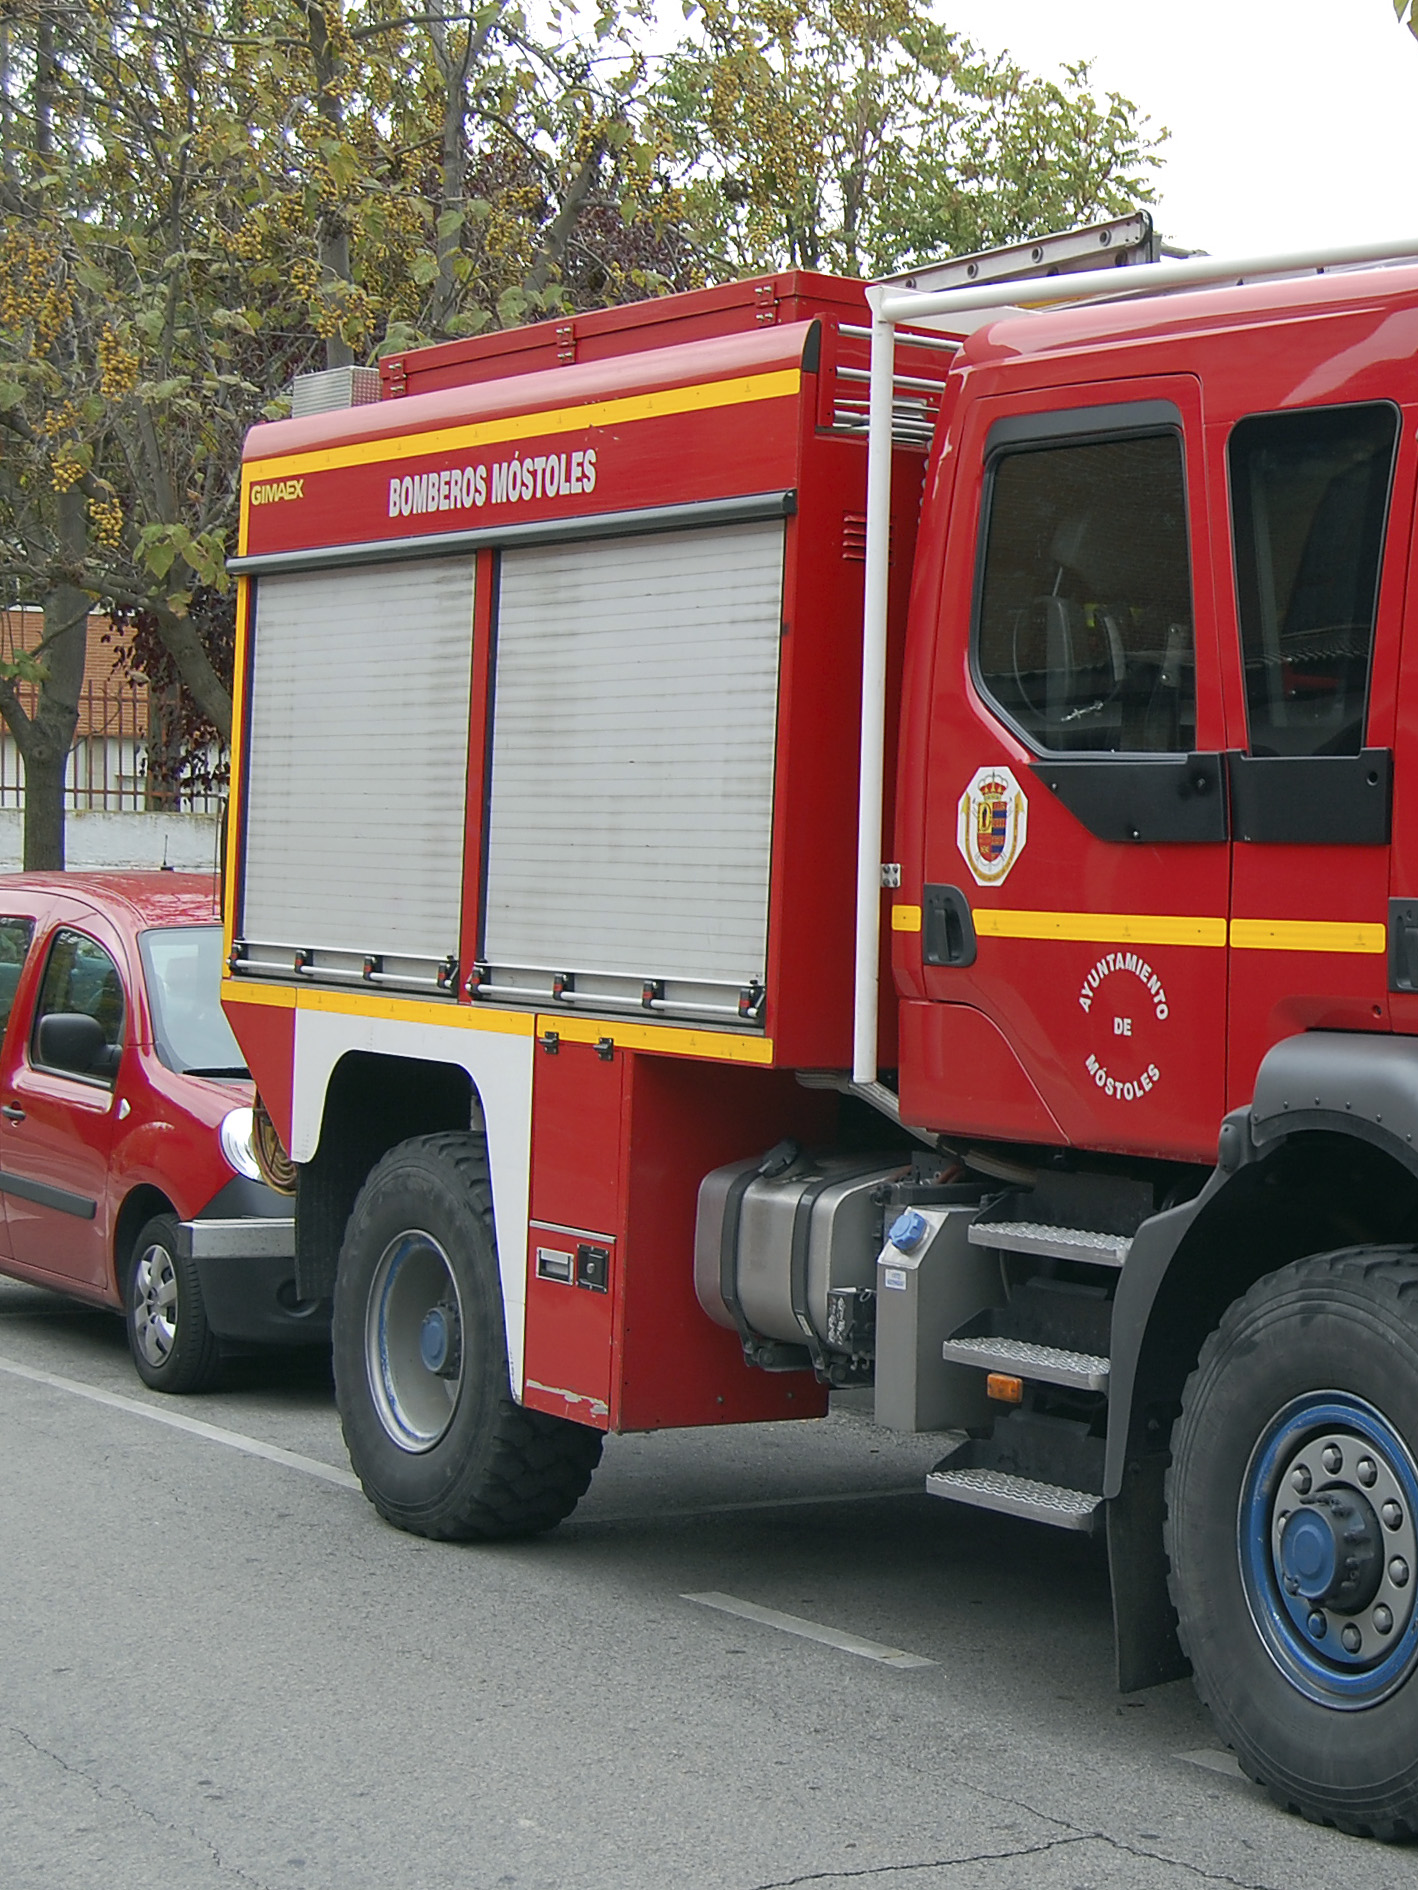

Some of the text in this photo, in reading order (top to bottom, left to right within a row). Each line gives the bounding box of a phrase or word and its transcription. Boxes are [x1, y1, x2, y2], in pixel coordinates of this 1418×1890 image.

[251, 479, 305, 506] GIMAEX
[388, 450, 597, 518] BOMBEROS MÓSTOLES
[1078, 952, 1170, 1021] AYUNTAMIENTO
[1113, 1016, 1133, 1037] DE
[1084, 1053, 1161, 1102] MÓSTOLES
